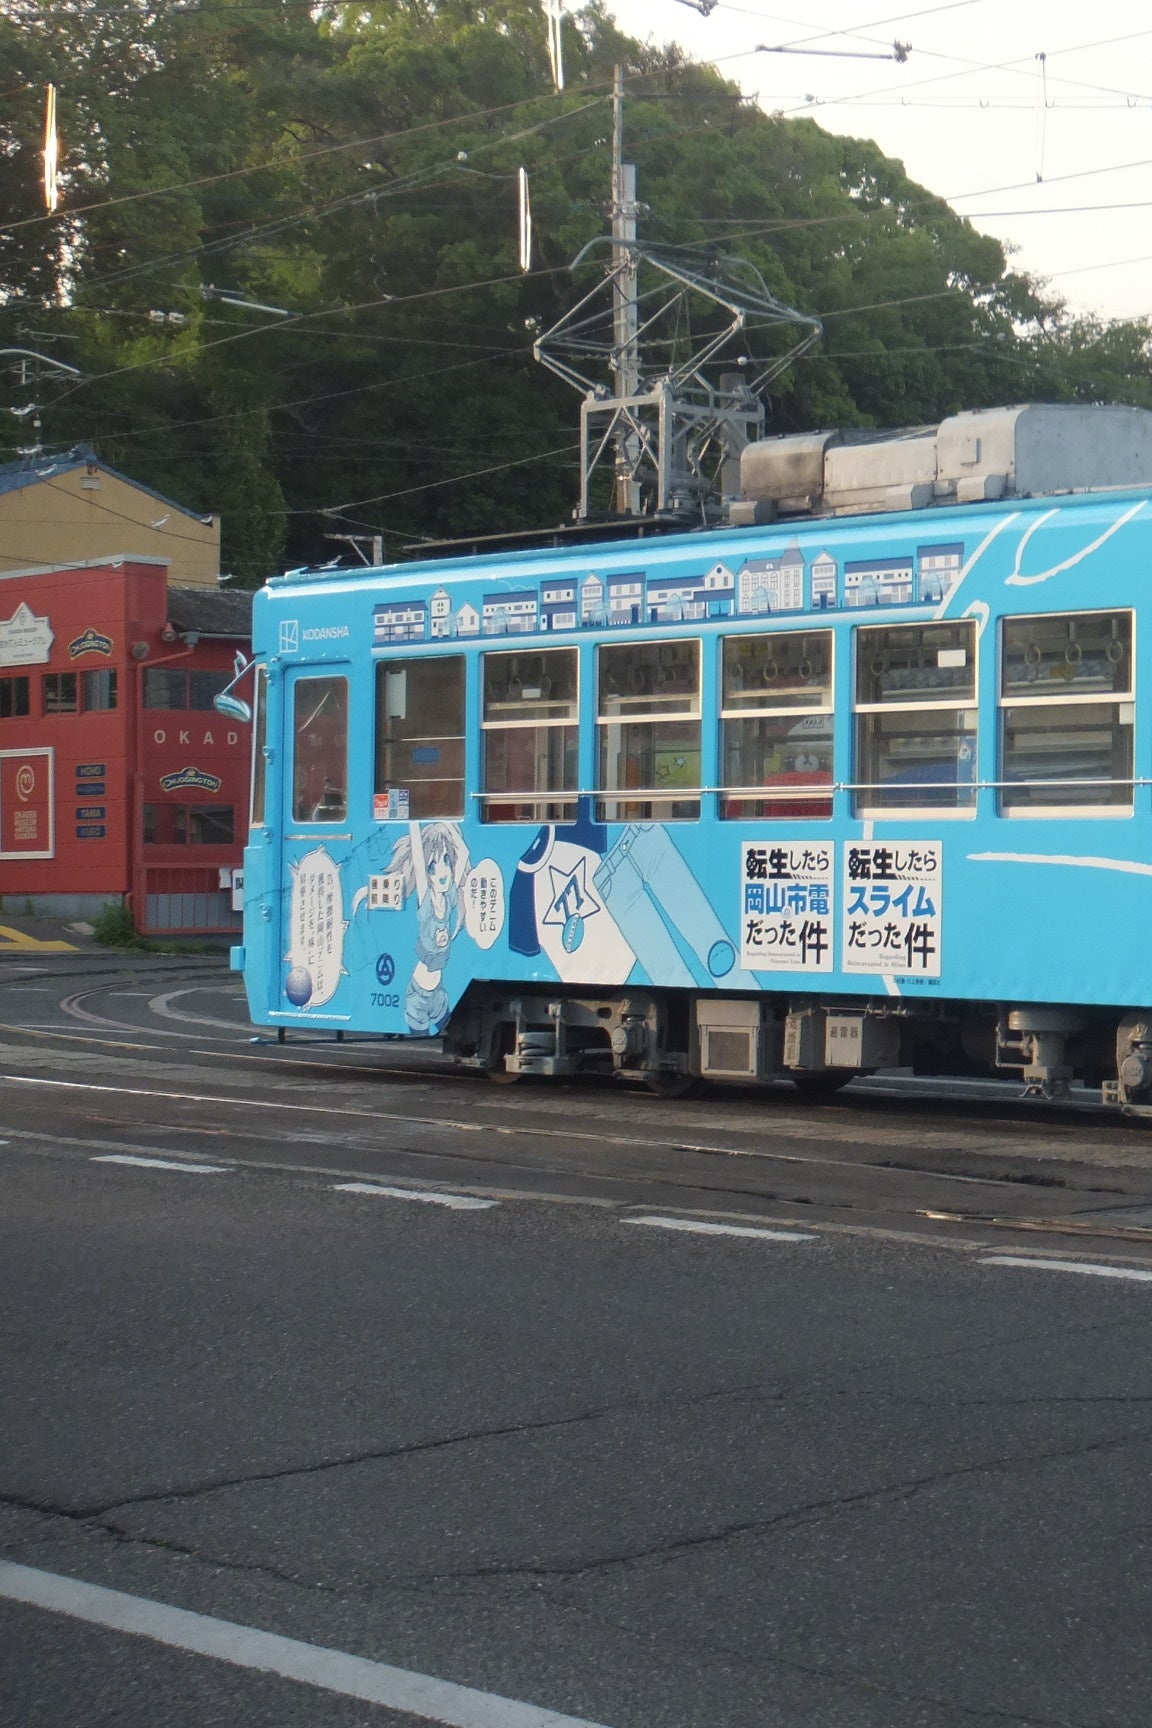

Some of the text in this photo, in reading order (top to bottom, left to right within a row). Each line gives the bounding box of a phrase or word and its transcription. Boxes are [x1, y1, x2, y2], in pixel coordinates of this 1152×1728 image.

[302, 625, 349, 641] KODANSHA
[745, 848, 830, 880] 転生したら
[848, 848, 938, 881] 転生したら
[371, 879, 401, 892] 後乗り
[371, 893, 401, 906] 前降り
[554, 875, 585, 923] 77
[745, 883, 830, 915] 岡山市電
[847, 884, 936, 918] スライム
[745, 919, 829, 965] だった件
[848, 921, 936, 968] だった件
[878, 953, 907, 962] Regarding
[847, 960, 883, 968] Reincarnated
[370, 993, 400, 1008] 7002
